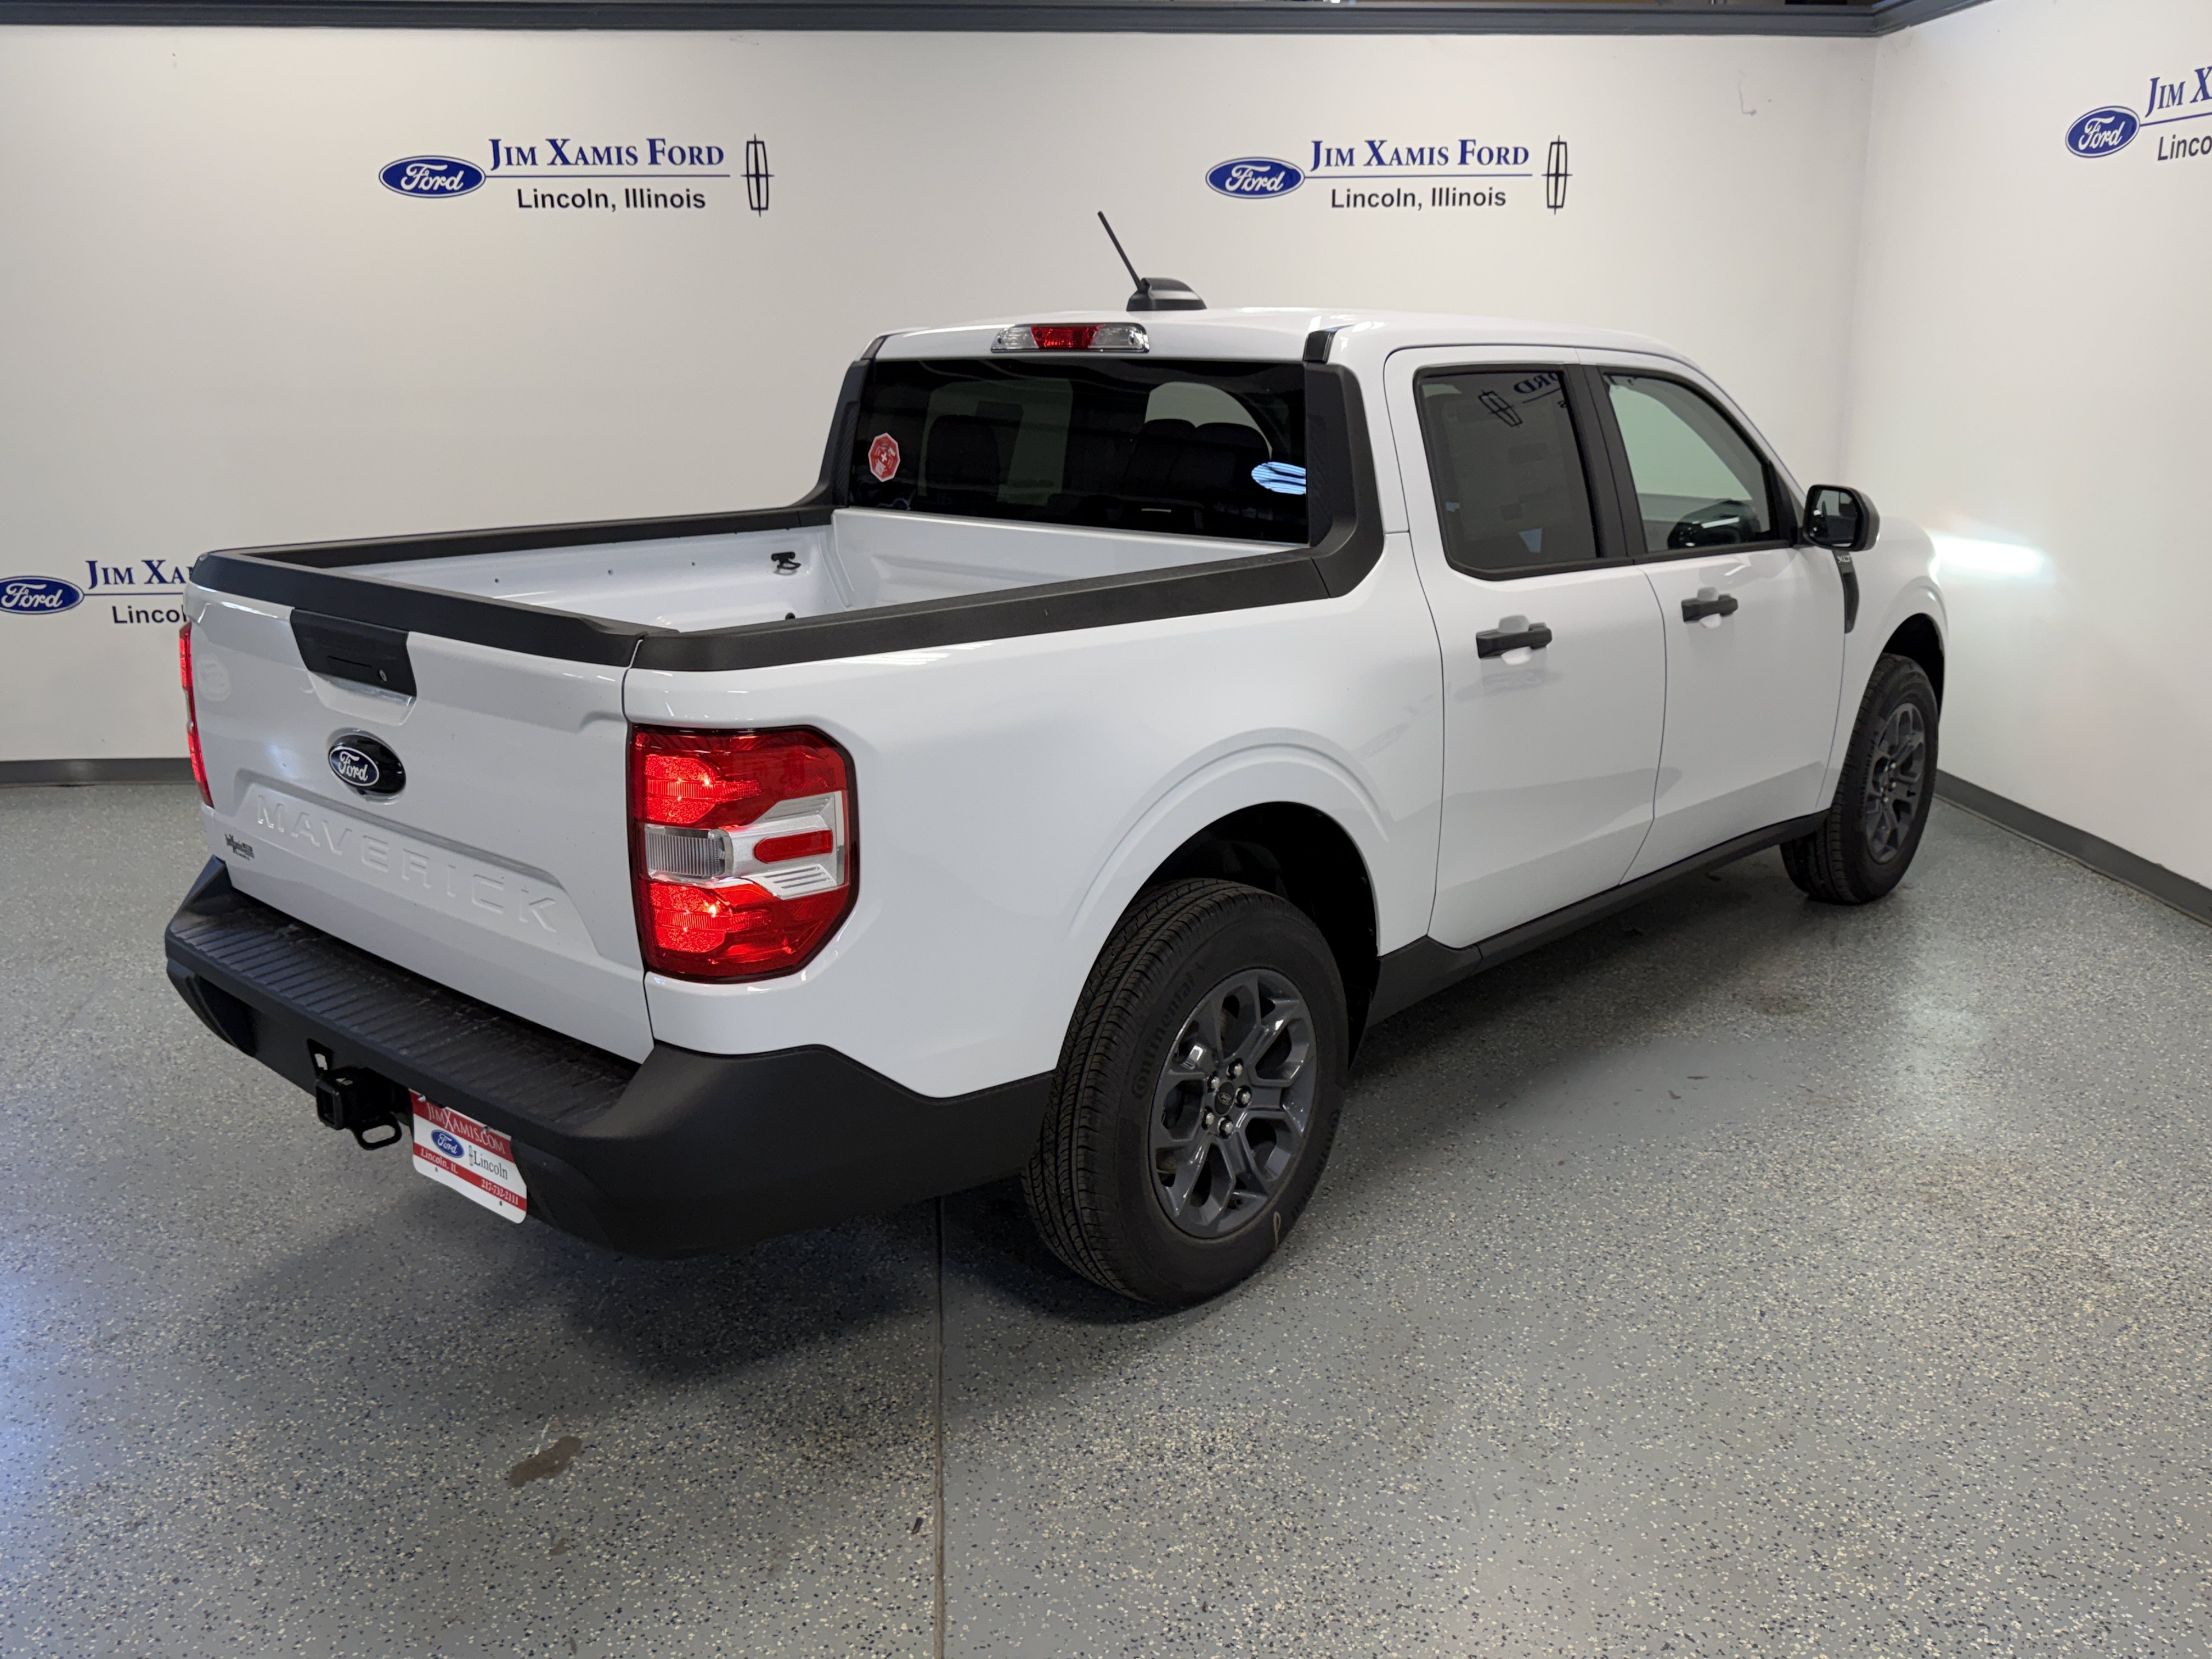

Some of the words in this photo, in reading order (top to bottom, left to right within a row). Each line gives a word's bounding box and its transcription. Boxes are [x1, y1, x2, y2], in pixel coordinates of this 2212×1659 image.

[2145, 76, 2186, 118] JIM
[2078, 116, 2125, 151] Ford
[488, 138, 538, 171] JIM
[545, 138, 638, 166] XAMIS
[646, 138, 724, 166] FORD
[1310, 140, 1355, 172] JIM
[1363, 139, 1449, 166] XAMIS
[1457, 139, 1530, 166] FORD
[2157, 134, 2212, 161] Linco
[400, 163, 464, 191] Ford
[1224, 165, 1286, 192] Ford
[517, 188, 616, 212] Lincoln,
[625, 188, 706, 208] Illinois
[1331, 187, 1423, 211] Lincoln,
[1431, 187, 1507, 207] Illinois
[85, 560, 136, 590] JIM
[1, 582, 63, 608] Ford
[112, 604, 187, 624] Lincol
[338, 751, 369, 782] Ford
[256, 794, 556, 933] MAVERICK
[437, 1133, 458, 1154] Ford
[421, 1148, 449, 1170] Lincoln,
[450, 1164, 459, 1174] IL
[473, 1150, 508, 1180] Lincoln
[481, 1178, 518, 1205] 217-732-2111
